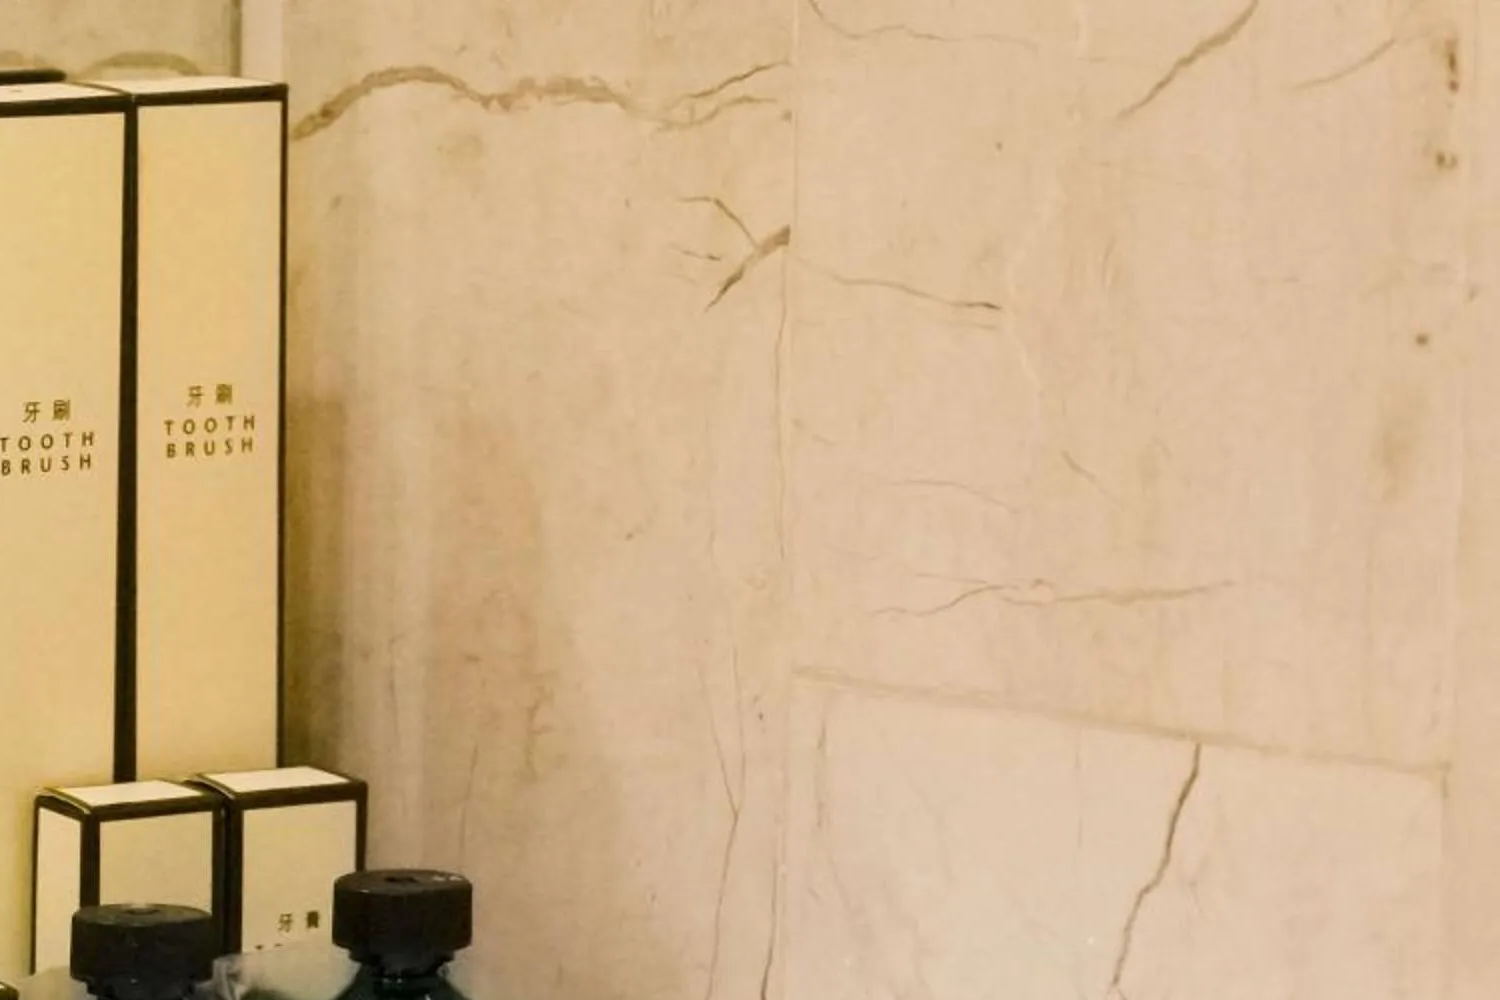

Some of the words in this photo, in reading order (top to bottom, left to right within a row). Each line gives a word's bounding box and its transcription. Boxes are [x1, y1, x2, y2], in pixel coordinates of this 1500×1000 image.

[23, 400, 71, 423] 牙刷
[164, 415, 255, 435] TOOTH
[166, 438, 254, 458] BRUSH
[1, 454, 92, 476] BRUSH
